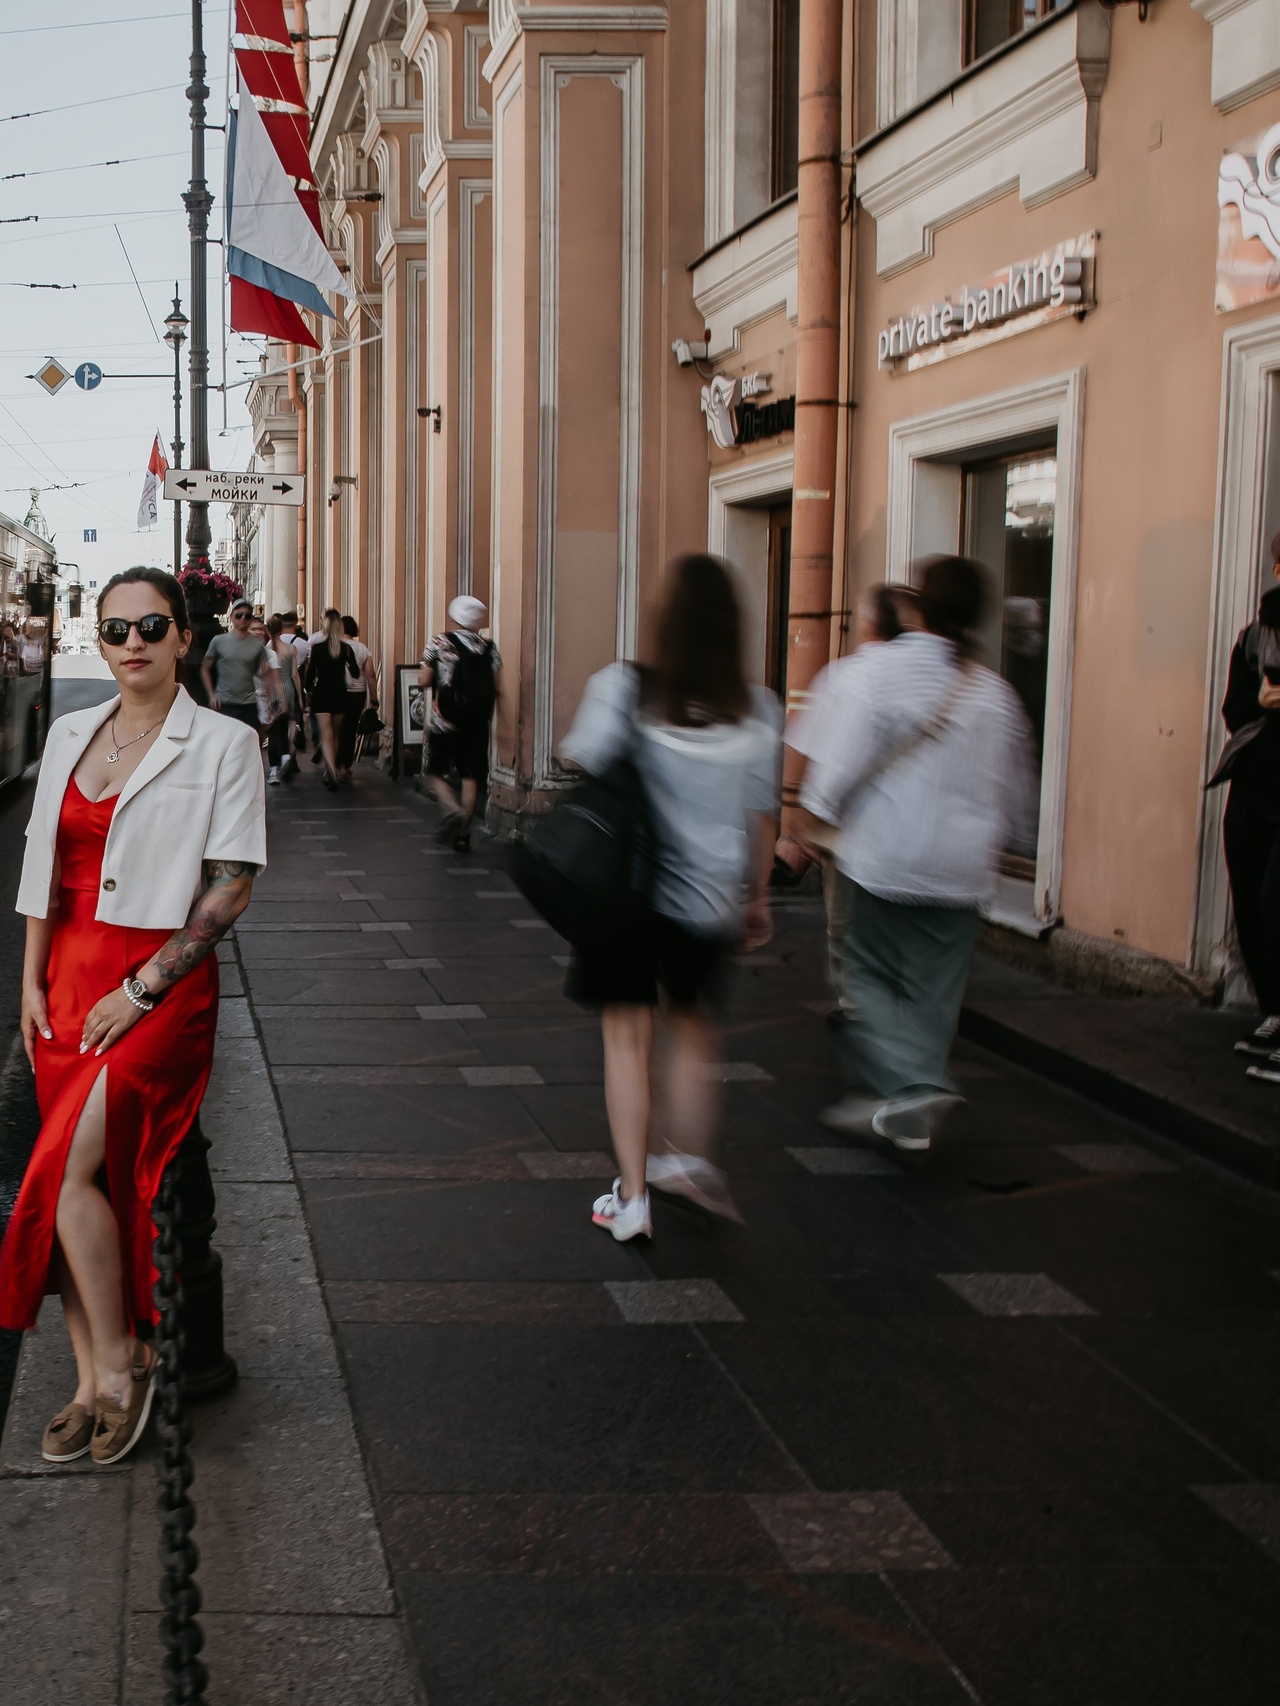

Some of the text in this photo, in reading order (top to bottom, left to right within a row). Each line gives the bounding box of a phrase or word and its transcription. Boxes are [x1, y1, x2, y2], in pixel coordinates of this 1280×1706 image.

[877, 255, 1067, 372] private banking
[741, 371, 761, 398] БКС
[205, 473, 265, 486] наб. реки
[211, 486, 258, 500] МОЙКИ
